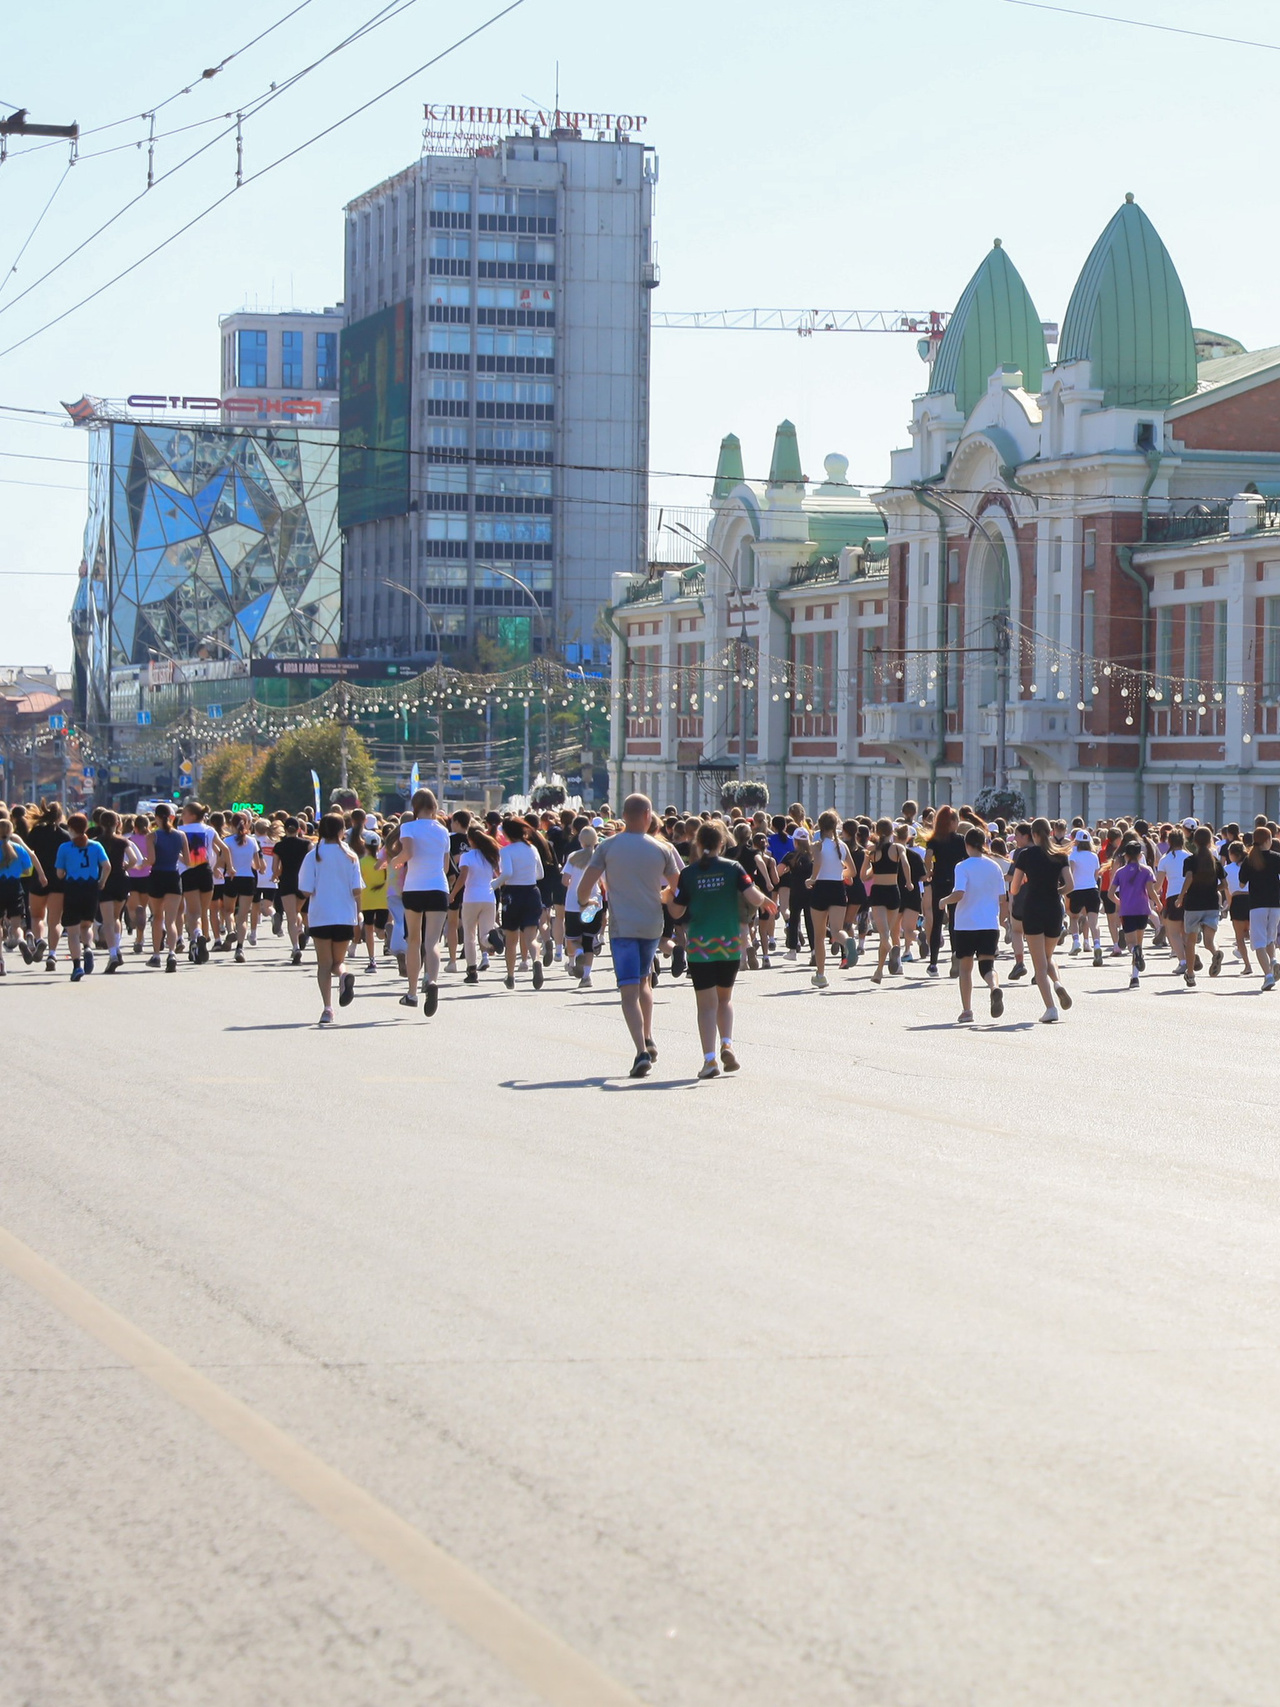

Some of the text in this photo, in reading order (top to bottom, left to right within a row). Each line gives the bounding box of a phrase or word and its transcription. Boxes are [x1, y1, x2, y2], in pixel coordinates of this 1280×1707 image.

[422, 103, 648, 132] КЛИНИКА ПРЕТОР
[79, 848, 90, 869] 3
